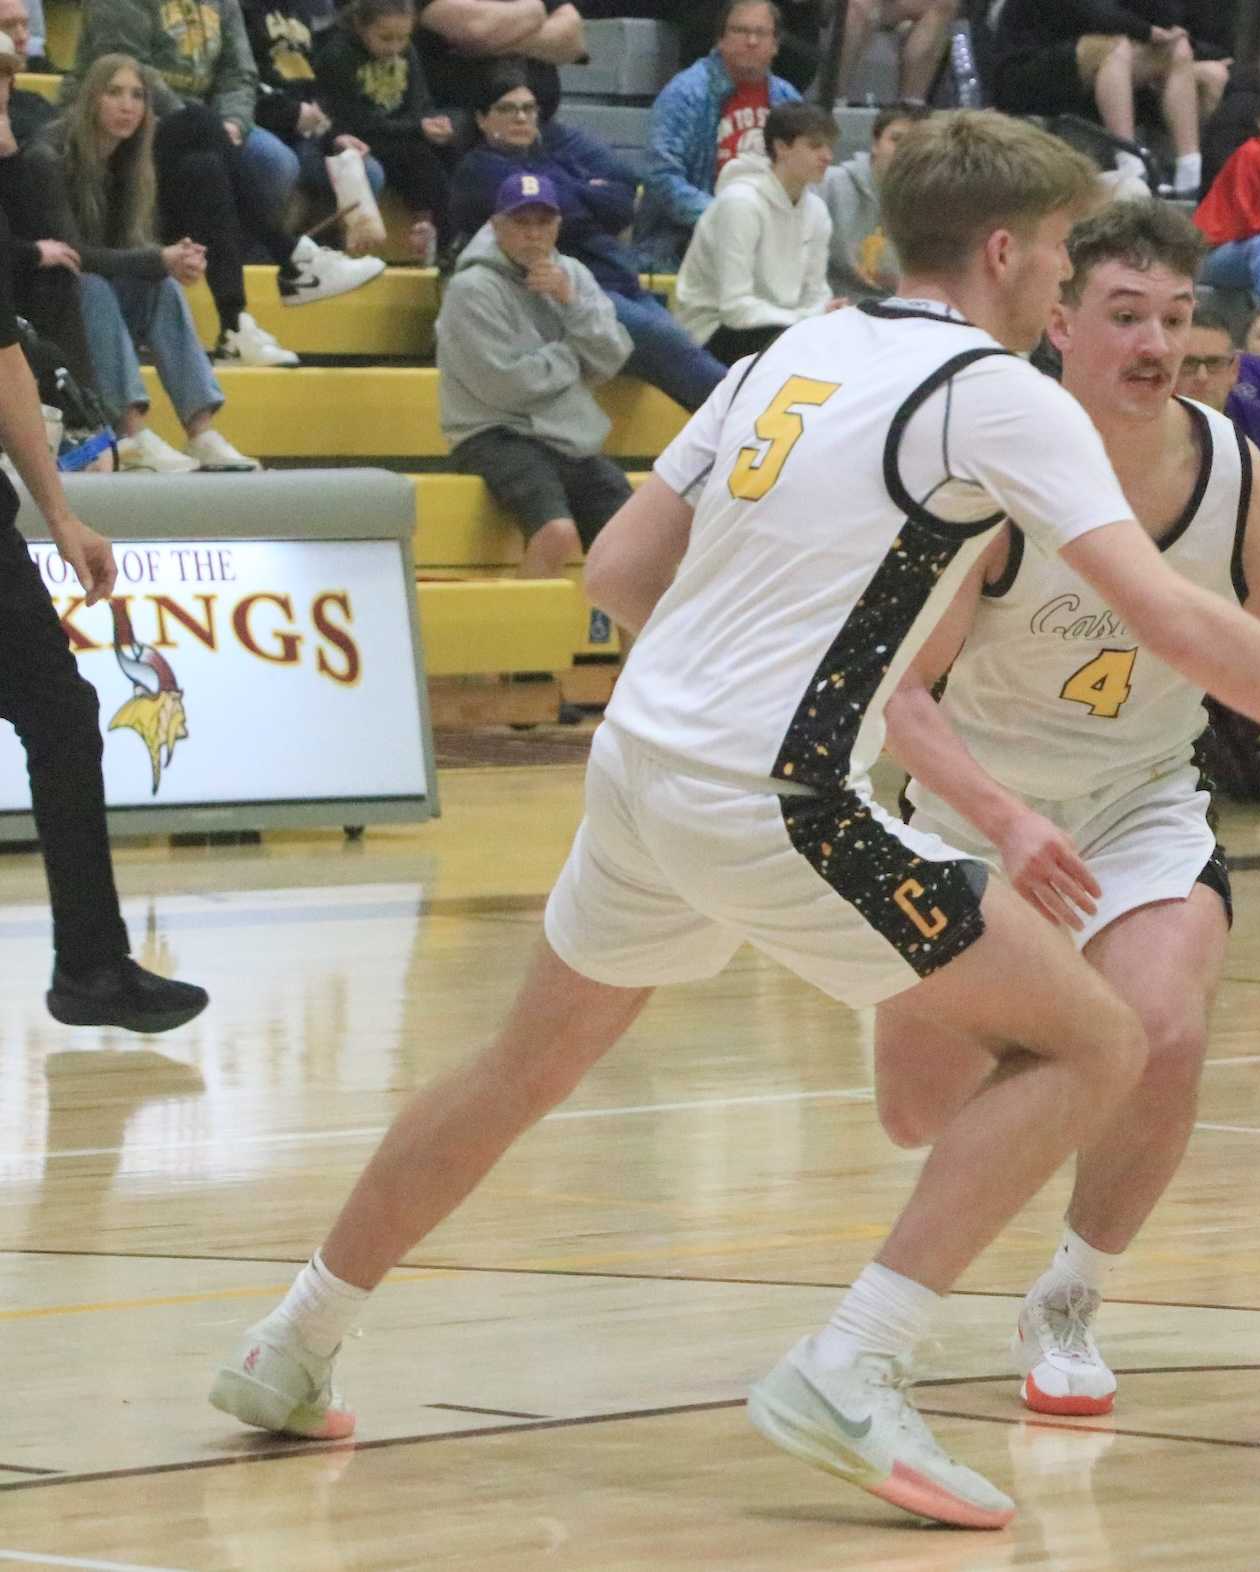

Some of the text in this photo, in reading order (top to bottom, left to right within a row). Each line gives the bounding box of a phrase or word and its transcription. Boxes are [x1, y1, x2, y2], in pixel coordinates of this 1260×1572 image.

[521, 175, 540, 197] B
[727, 374, 842, 502] 5
[122, 549, 160, 583] OF
[171, 549, 237, 582] THE
[54, 590, 364, 687] KINGS
[1058, 646, 1138, 719] 4
[893, 878, 948, 939] C
